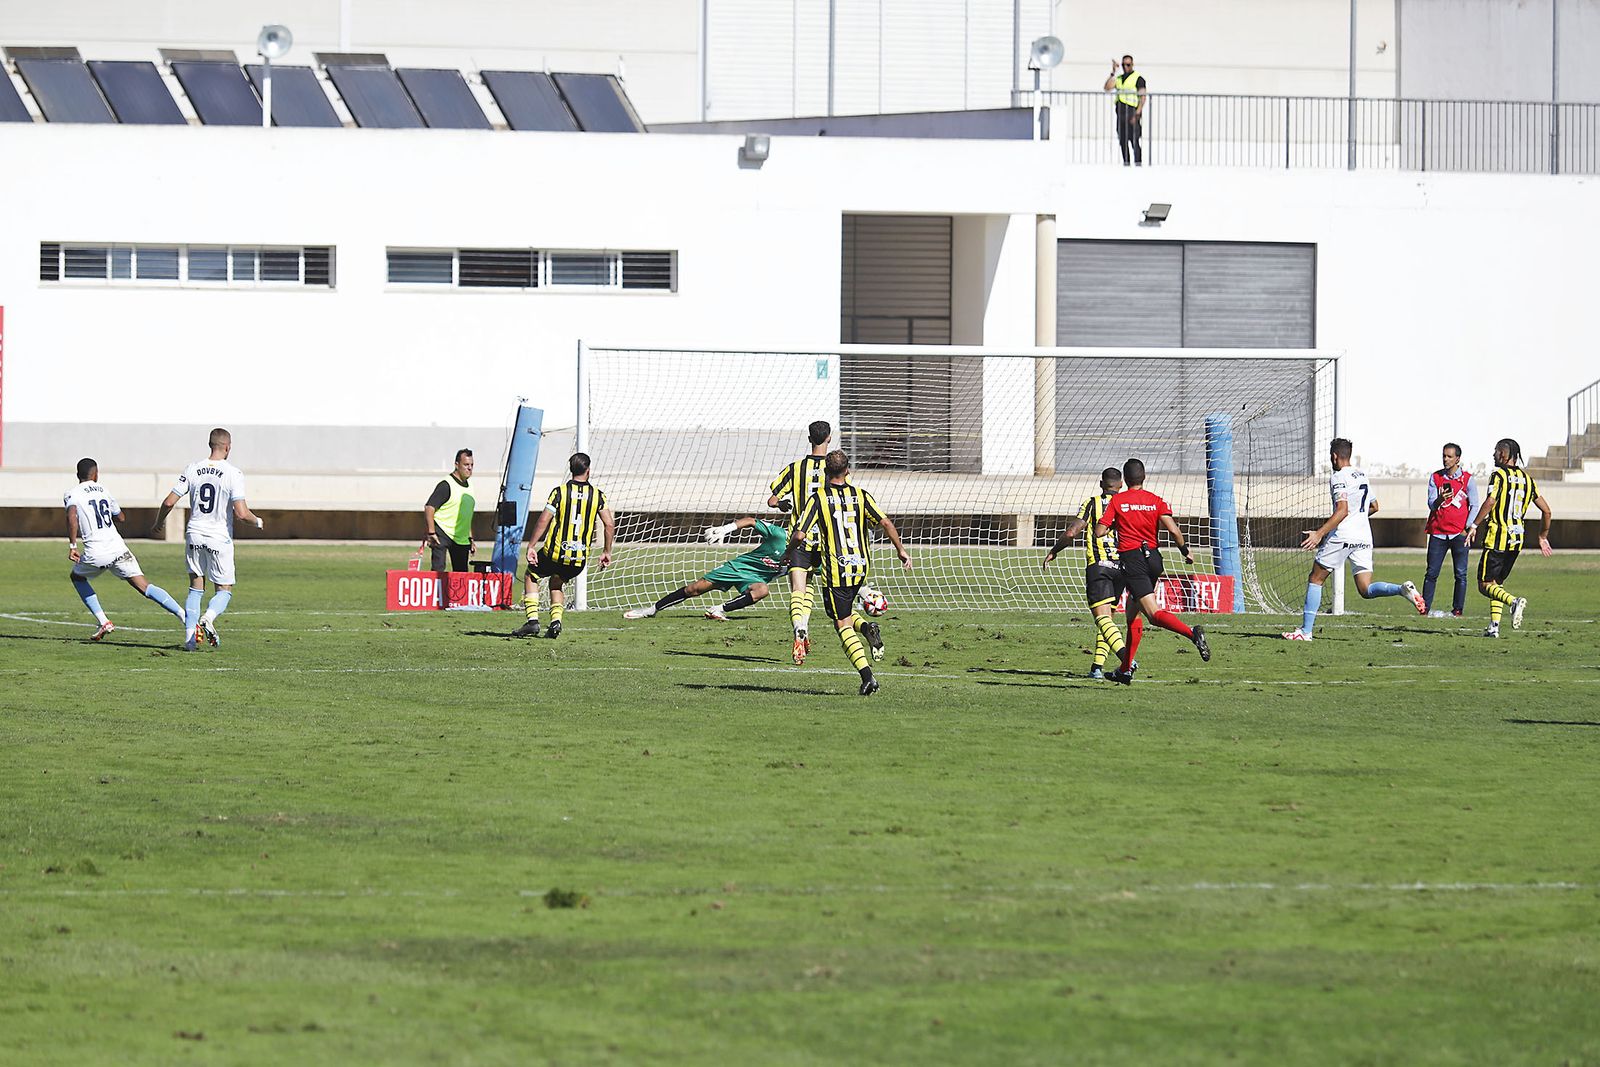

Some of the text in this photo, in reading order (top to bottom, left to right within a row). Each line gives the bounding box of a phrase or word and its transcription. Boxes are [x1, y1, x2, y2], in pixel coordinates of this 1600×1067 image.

[196, 467, 224, 478] DOVBYK
[88, 498, 112, 529] 16
[198, 483, 216, 514] 9
[1359, 483, 1368, 513] 7
[1509, 489, 1525, 520] 16
[570, 504, 582, 536] 4
[833, 510, 858, 548] 15
[398, 577, 443, 607] COPA
[468, 579, 500, 606] REY
